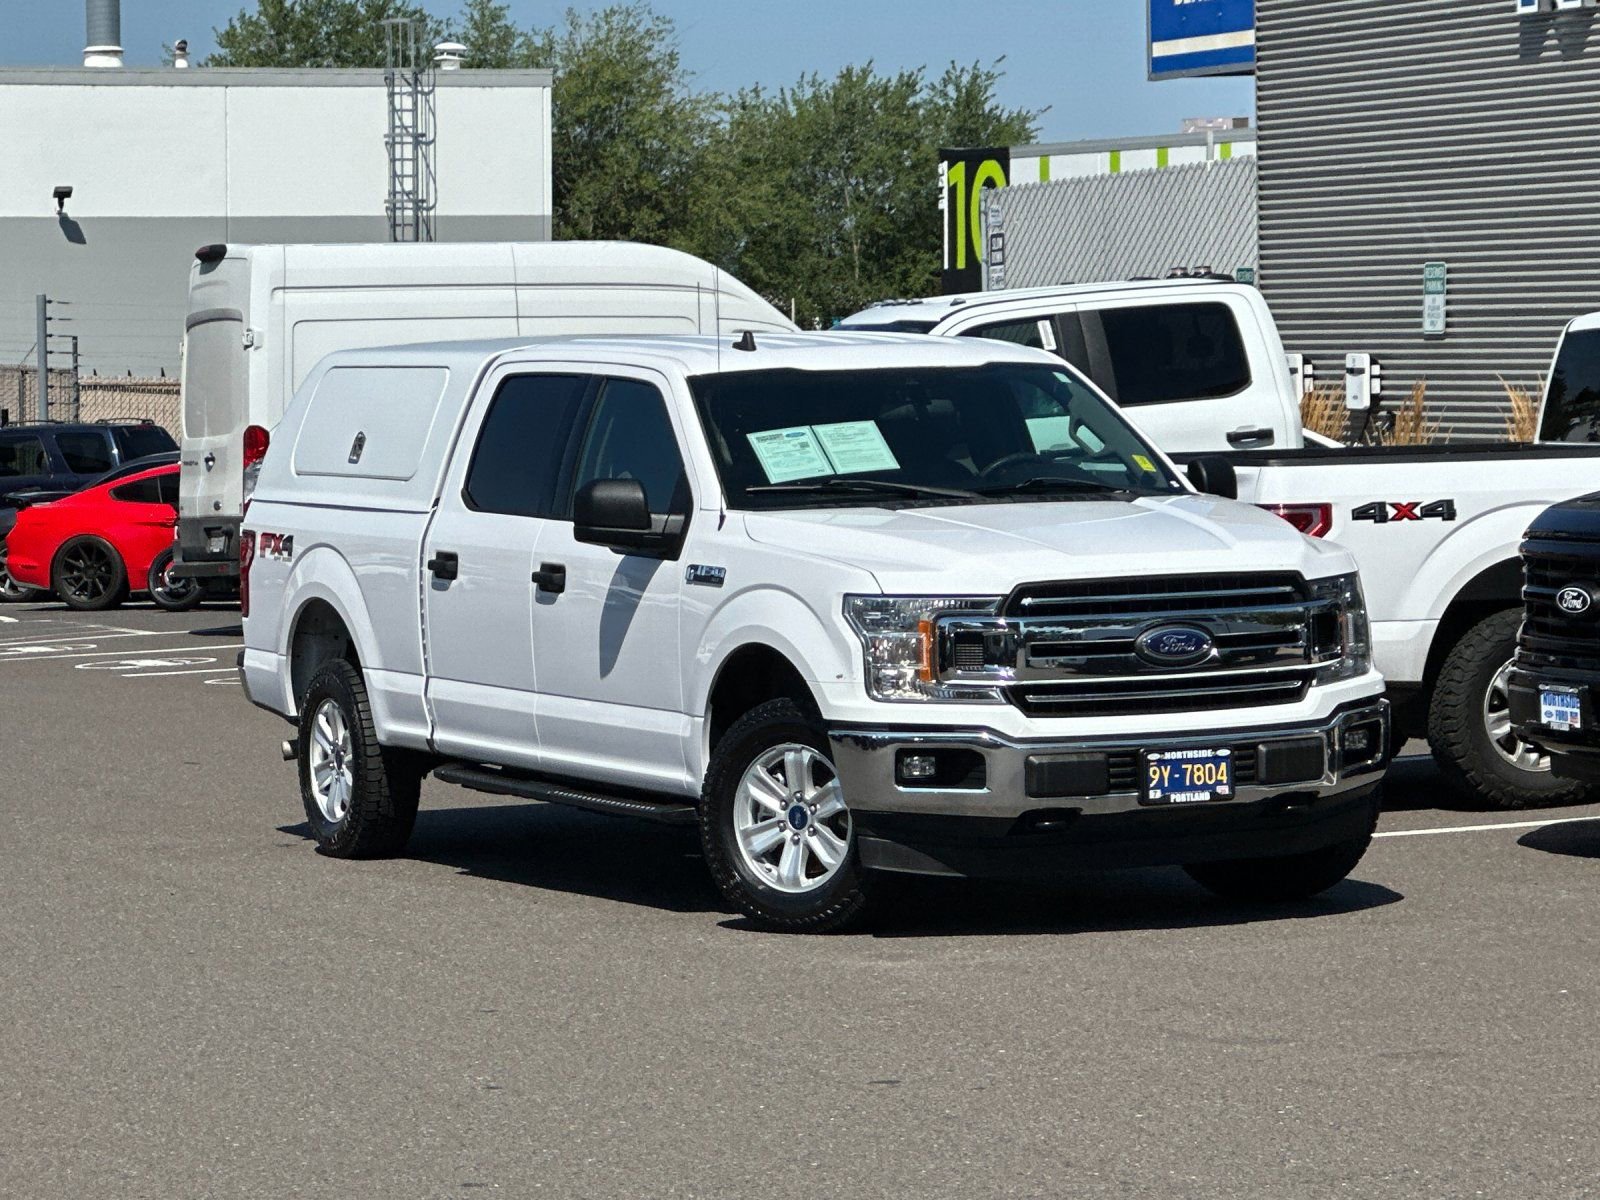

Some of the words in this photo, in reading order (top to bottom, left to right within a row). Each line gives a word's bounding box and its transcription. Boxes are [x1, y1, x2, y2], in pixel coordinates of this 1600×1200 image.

[260, 532, 294, 558] FX4
[1563, 591, 1583, 608] Ford
[1160, 634, 1197, 653] Ford
[1164, 749, 1213, 760] NORTHSIDE
[1149, 762, 1228, 788] 9Y-7804
[1170, 791, 1211, 803] PORTLAND
